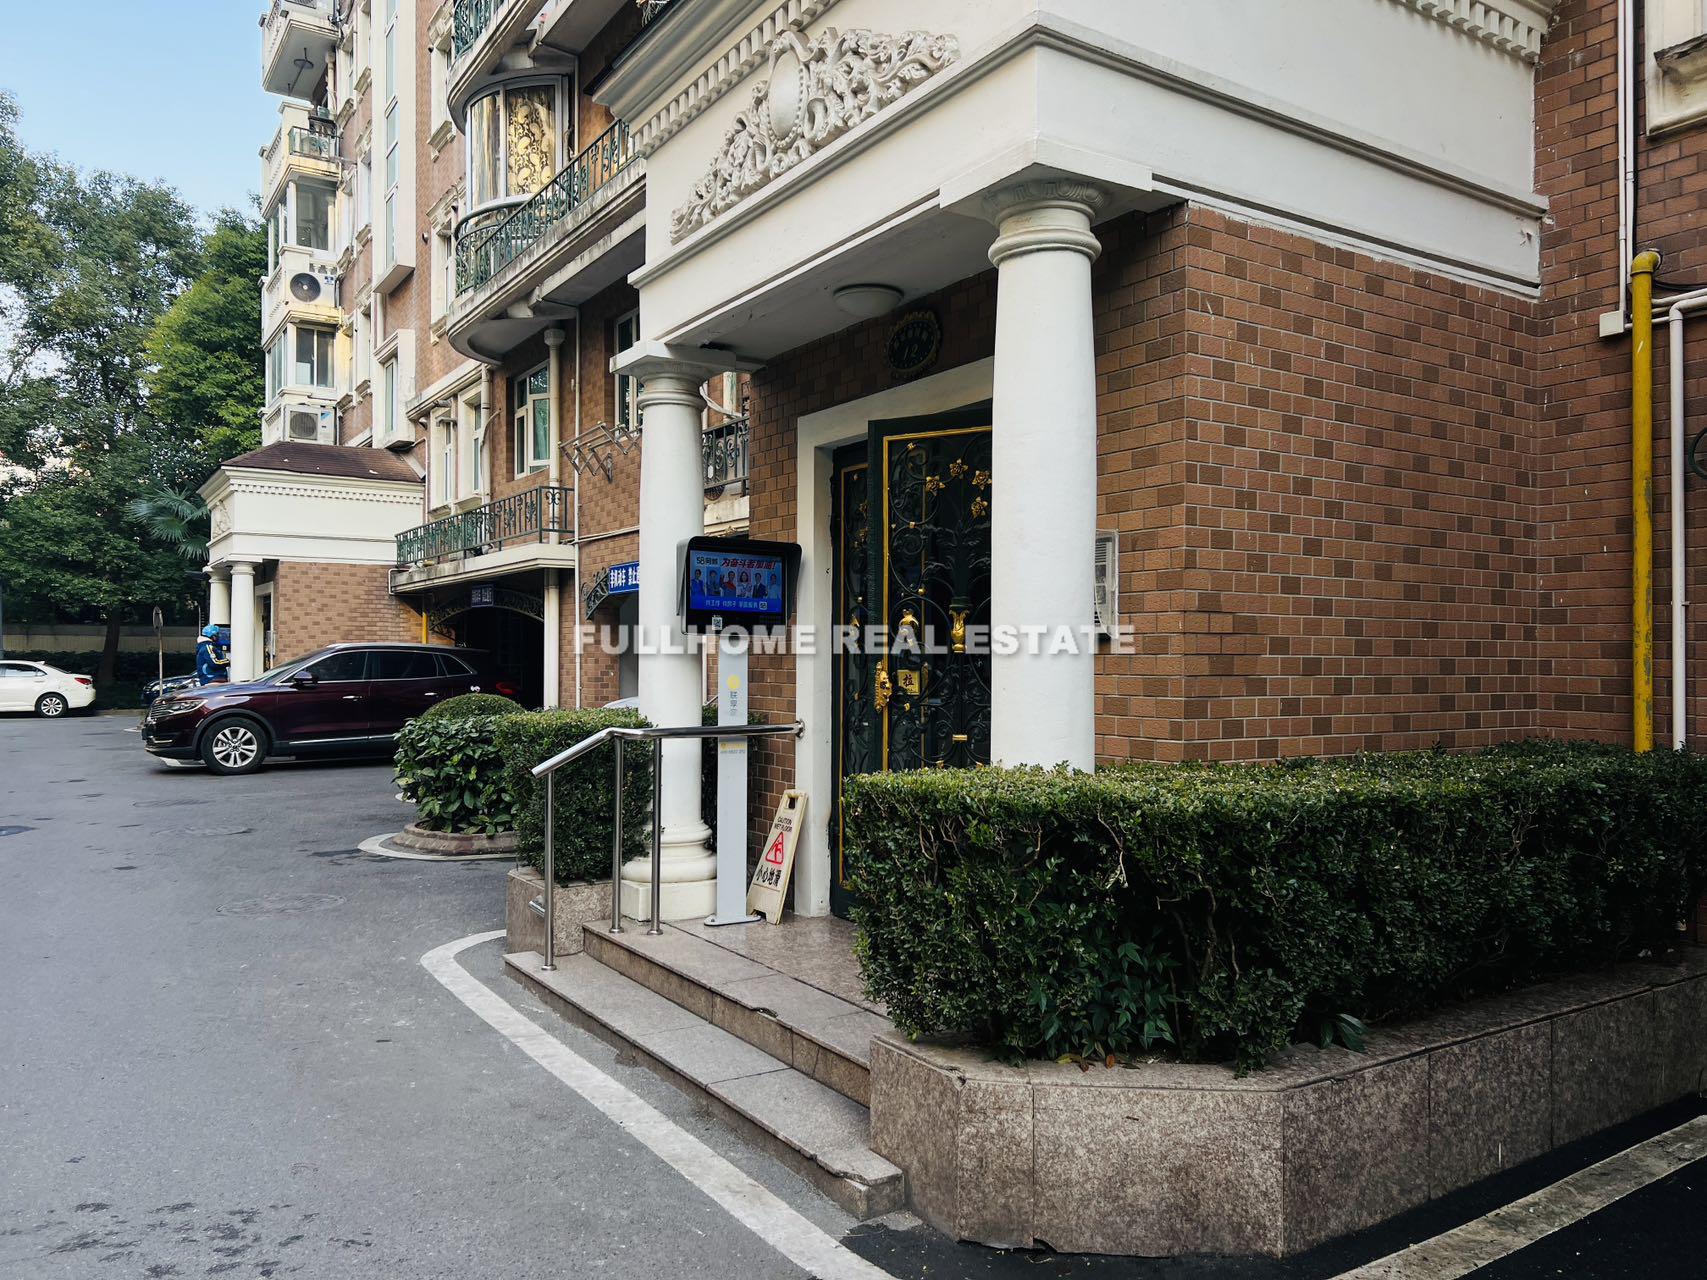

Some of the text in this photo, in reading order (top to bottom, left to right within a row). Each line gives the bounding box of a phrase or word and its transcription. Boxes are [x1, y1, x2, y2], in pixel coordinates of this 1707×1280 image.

[903, 674, 914, 687] 拉
[777, 816, 793, 825] CAUTION
[781, 824, 793, 833] FLOOR
[756, 864, 782, 887] 小心地滑
